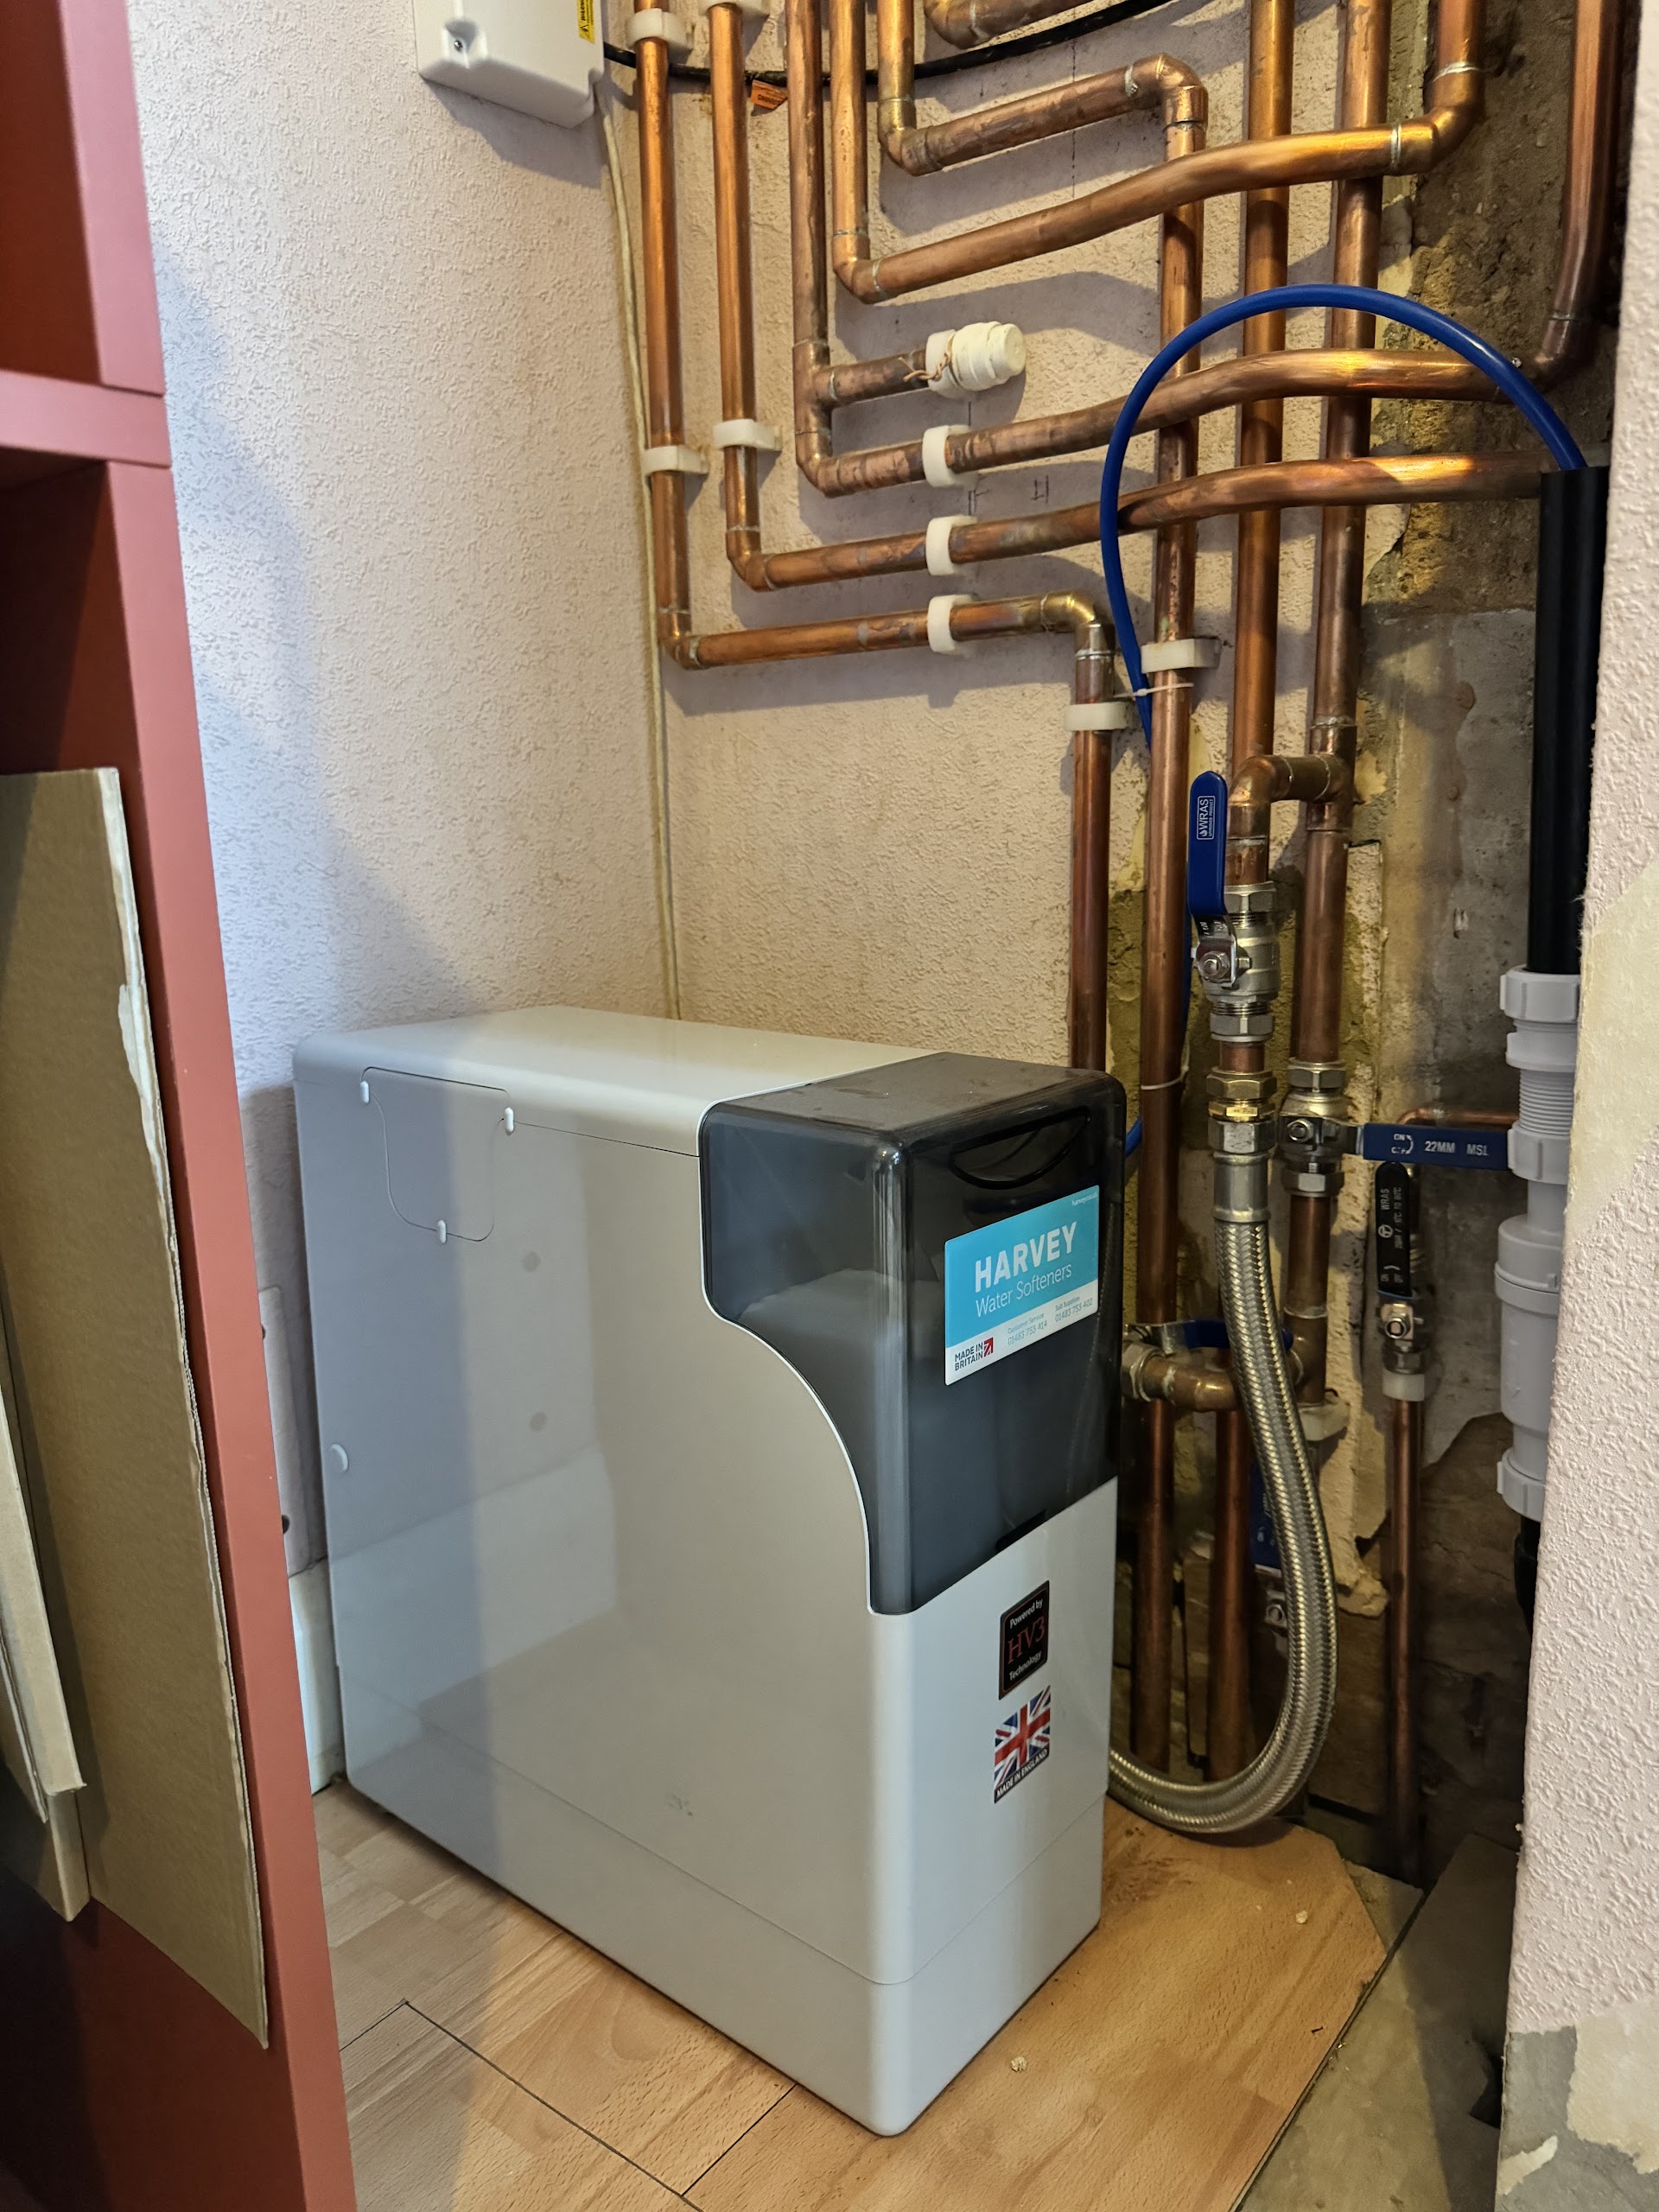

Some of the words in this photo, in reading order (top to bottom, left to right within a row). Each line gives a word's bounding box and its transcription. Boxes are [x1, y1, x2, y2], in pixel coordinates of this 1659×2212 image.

[1198, 798, 1209, 830] WRAS
[1425, 1141, 1456, 1154] 22MM
[1466, 1144, 1489, 1156] MSL
[1380, 1188, 1389, 1211] WRAS
[975, 1221, 1077, 1294] HARVEY
[976, 1290, 1014, 1318] Water
[1016, 1264, 1072, 1300] Softeners
[1028, 1313, 1045, 1325] Service
[1037, 1320, 1048, 1330] 414
[955, 1345, 975, 1363] MADE
[976, 1342, 983, 1352] IN
[955, 1351, 983, 1371] BRITAIN
[1009, 1602, 1035, 1629] Powered
[1035, 1598, 1043, 1609] by
[1008, 1616, 1046, 1664] HV3
[1008, 1650, 1043, 1681] Technology
[997, 1777, 1014, 1798] MADE
[1014, 1770, 1021, 1783] IN
[1021, 1748, 1048, 1778] ENGLAND
